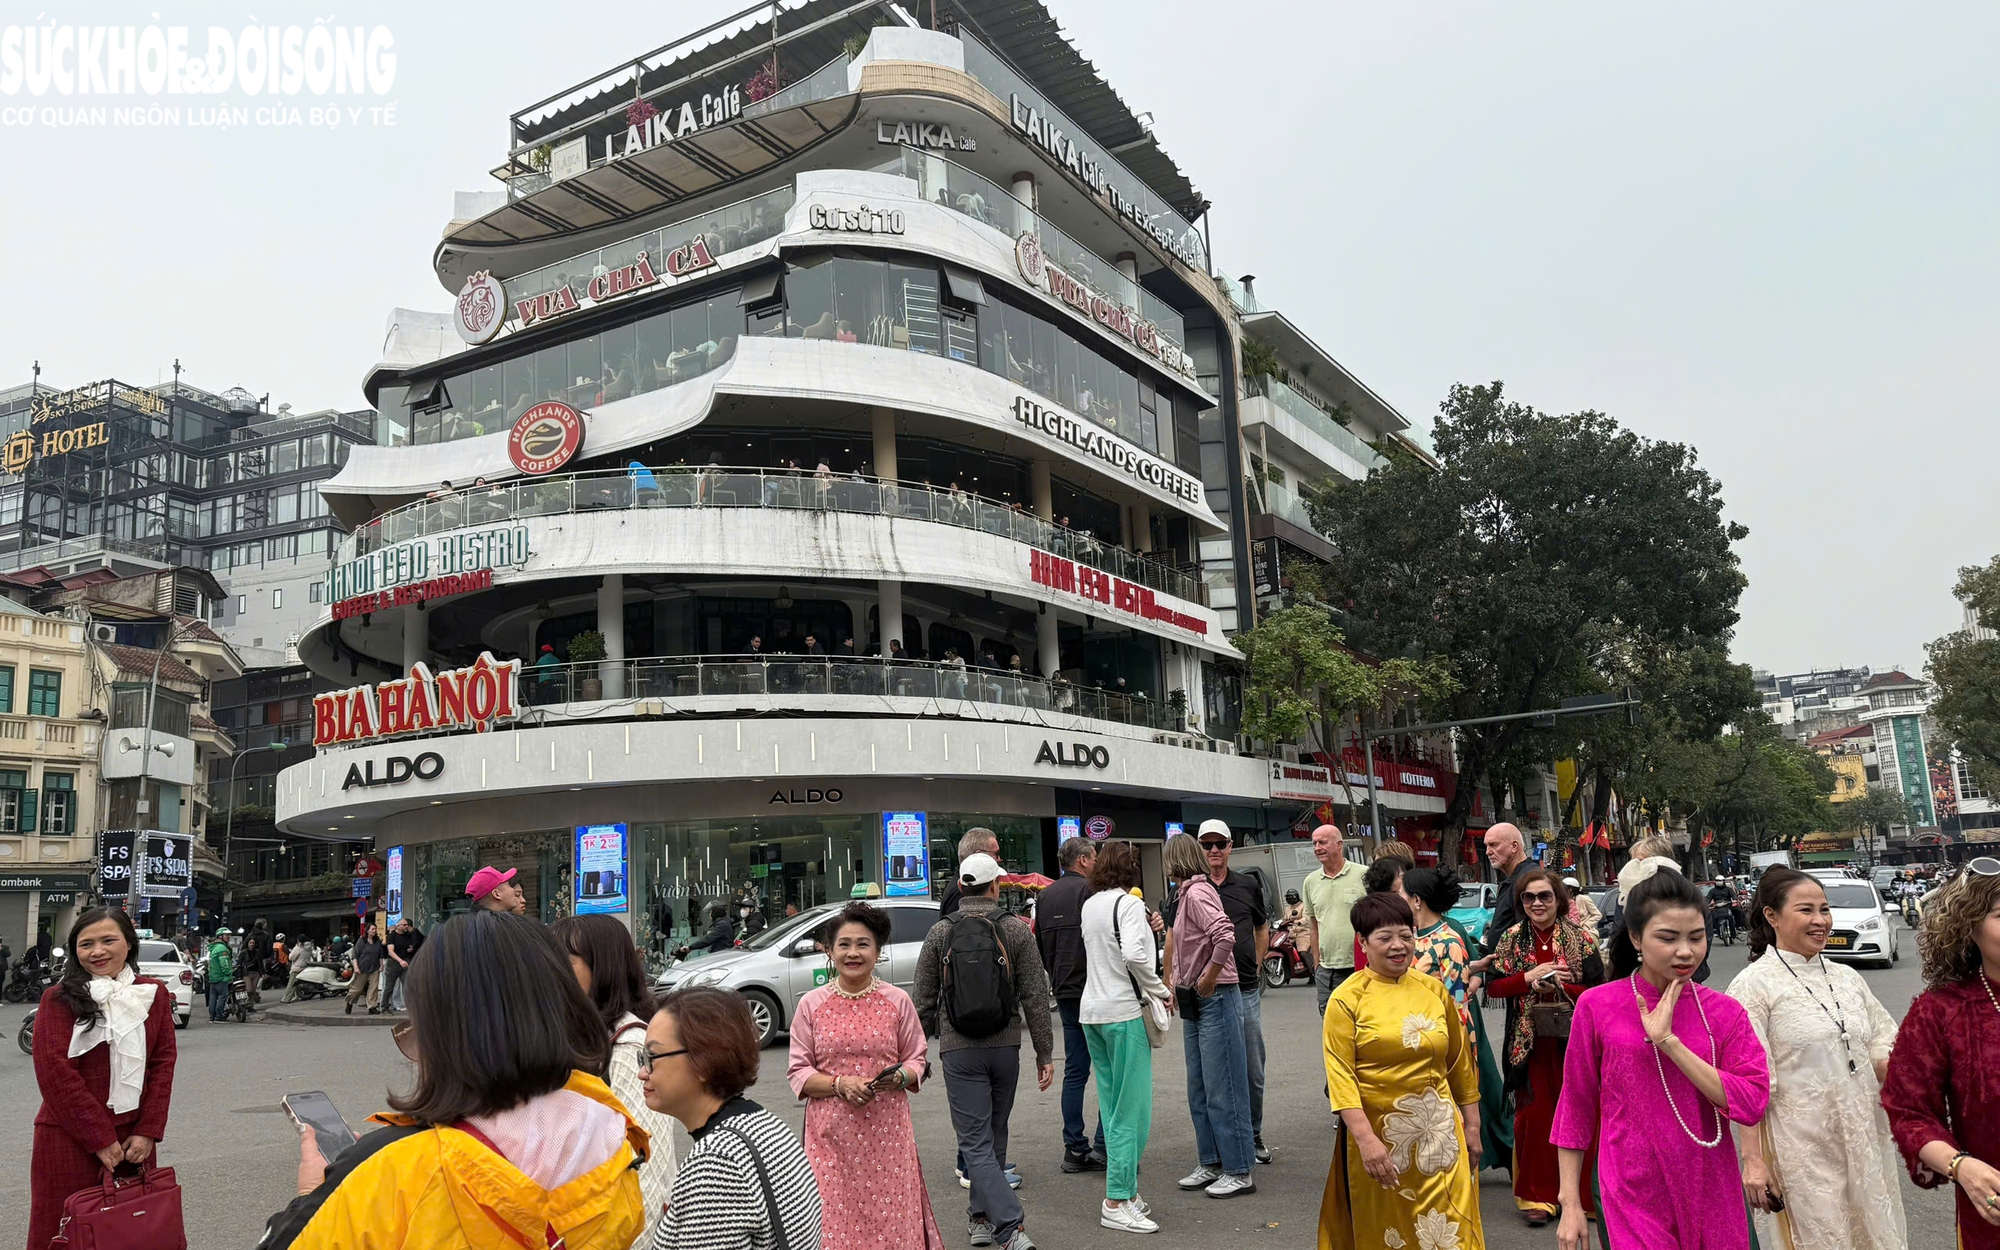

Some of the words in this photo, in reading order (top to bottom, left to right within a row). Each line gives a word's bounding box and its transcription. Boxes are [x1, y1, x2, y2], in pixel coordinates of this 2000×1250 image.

[605, 101, 698, 163] LAIKA
[701, 83, 742, 128] Café
[876, 118, 956, 149] LAIKA
[958, 135, 977, 152] Café
[1010, 92, 1081, 174] LAIKA
[1081, 151, 1105, 195] Café
[1107, 183, 1133, 218] The
[1134, 204, 1198, 272] Exceptional
[810, 203, 840, 230] Cơ
[845, 204, 873, 232] sở
[878, 209, 905, 234] 10
[515, 285, 579, 327] VUA
[587, 251, 660, 303] CHẢ
[666, 234, 717, 277] CÁ
[1046, 267, 1092, 319] VUA
[49, 408, 66, 420] SKY
[69, 399, 106, 414] LOUNGE
[512, 406, 576, 443] HIGHLANDS
[41, 422, 110, 458] HOTEL
[1016, 396, 1137, 473] HIGHLANDS
[1139, 459, 1199, 503] COFFEE
[521, 447, 570, 470] COFFEE
[378, 541, 428, 587] 1930
[438, 525, 529, 575] BISTRO
[331, 593, 377, 620] COFFEE
[379, 590, 392, 610] &
[393, 568, 493, 607] RESTAURANT
[342, 751, 446, 790] ALDO
[1034, 740, 1110, 769] ALDO
[769, 789, 843, 804] ALDO
[1402, 772, 1436, 788] LOTTERIA
[109, 846, 129, 859] FS
[148, 857, 163, 874] FS
[165, 858, 188, 877] SPA
[103, 865, 131, 879] SPA
[47, 894, 70, 902] ATM
